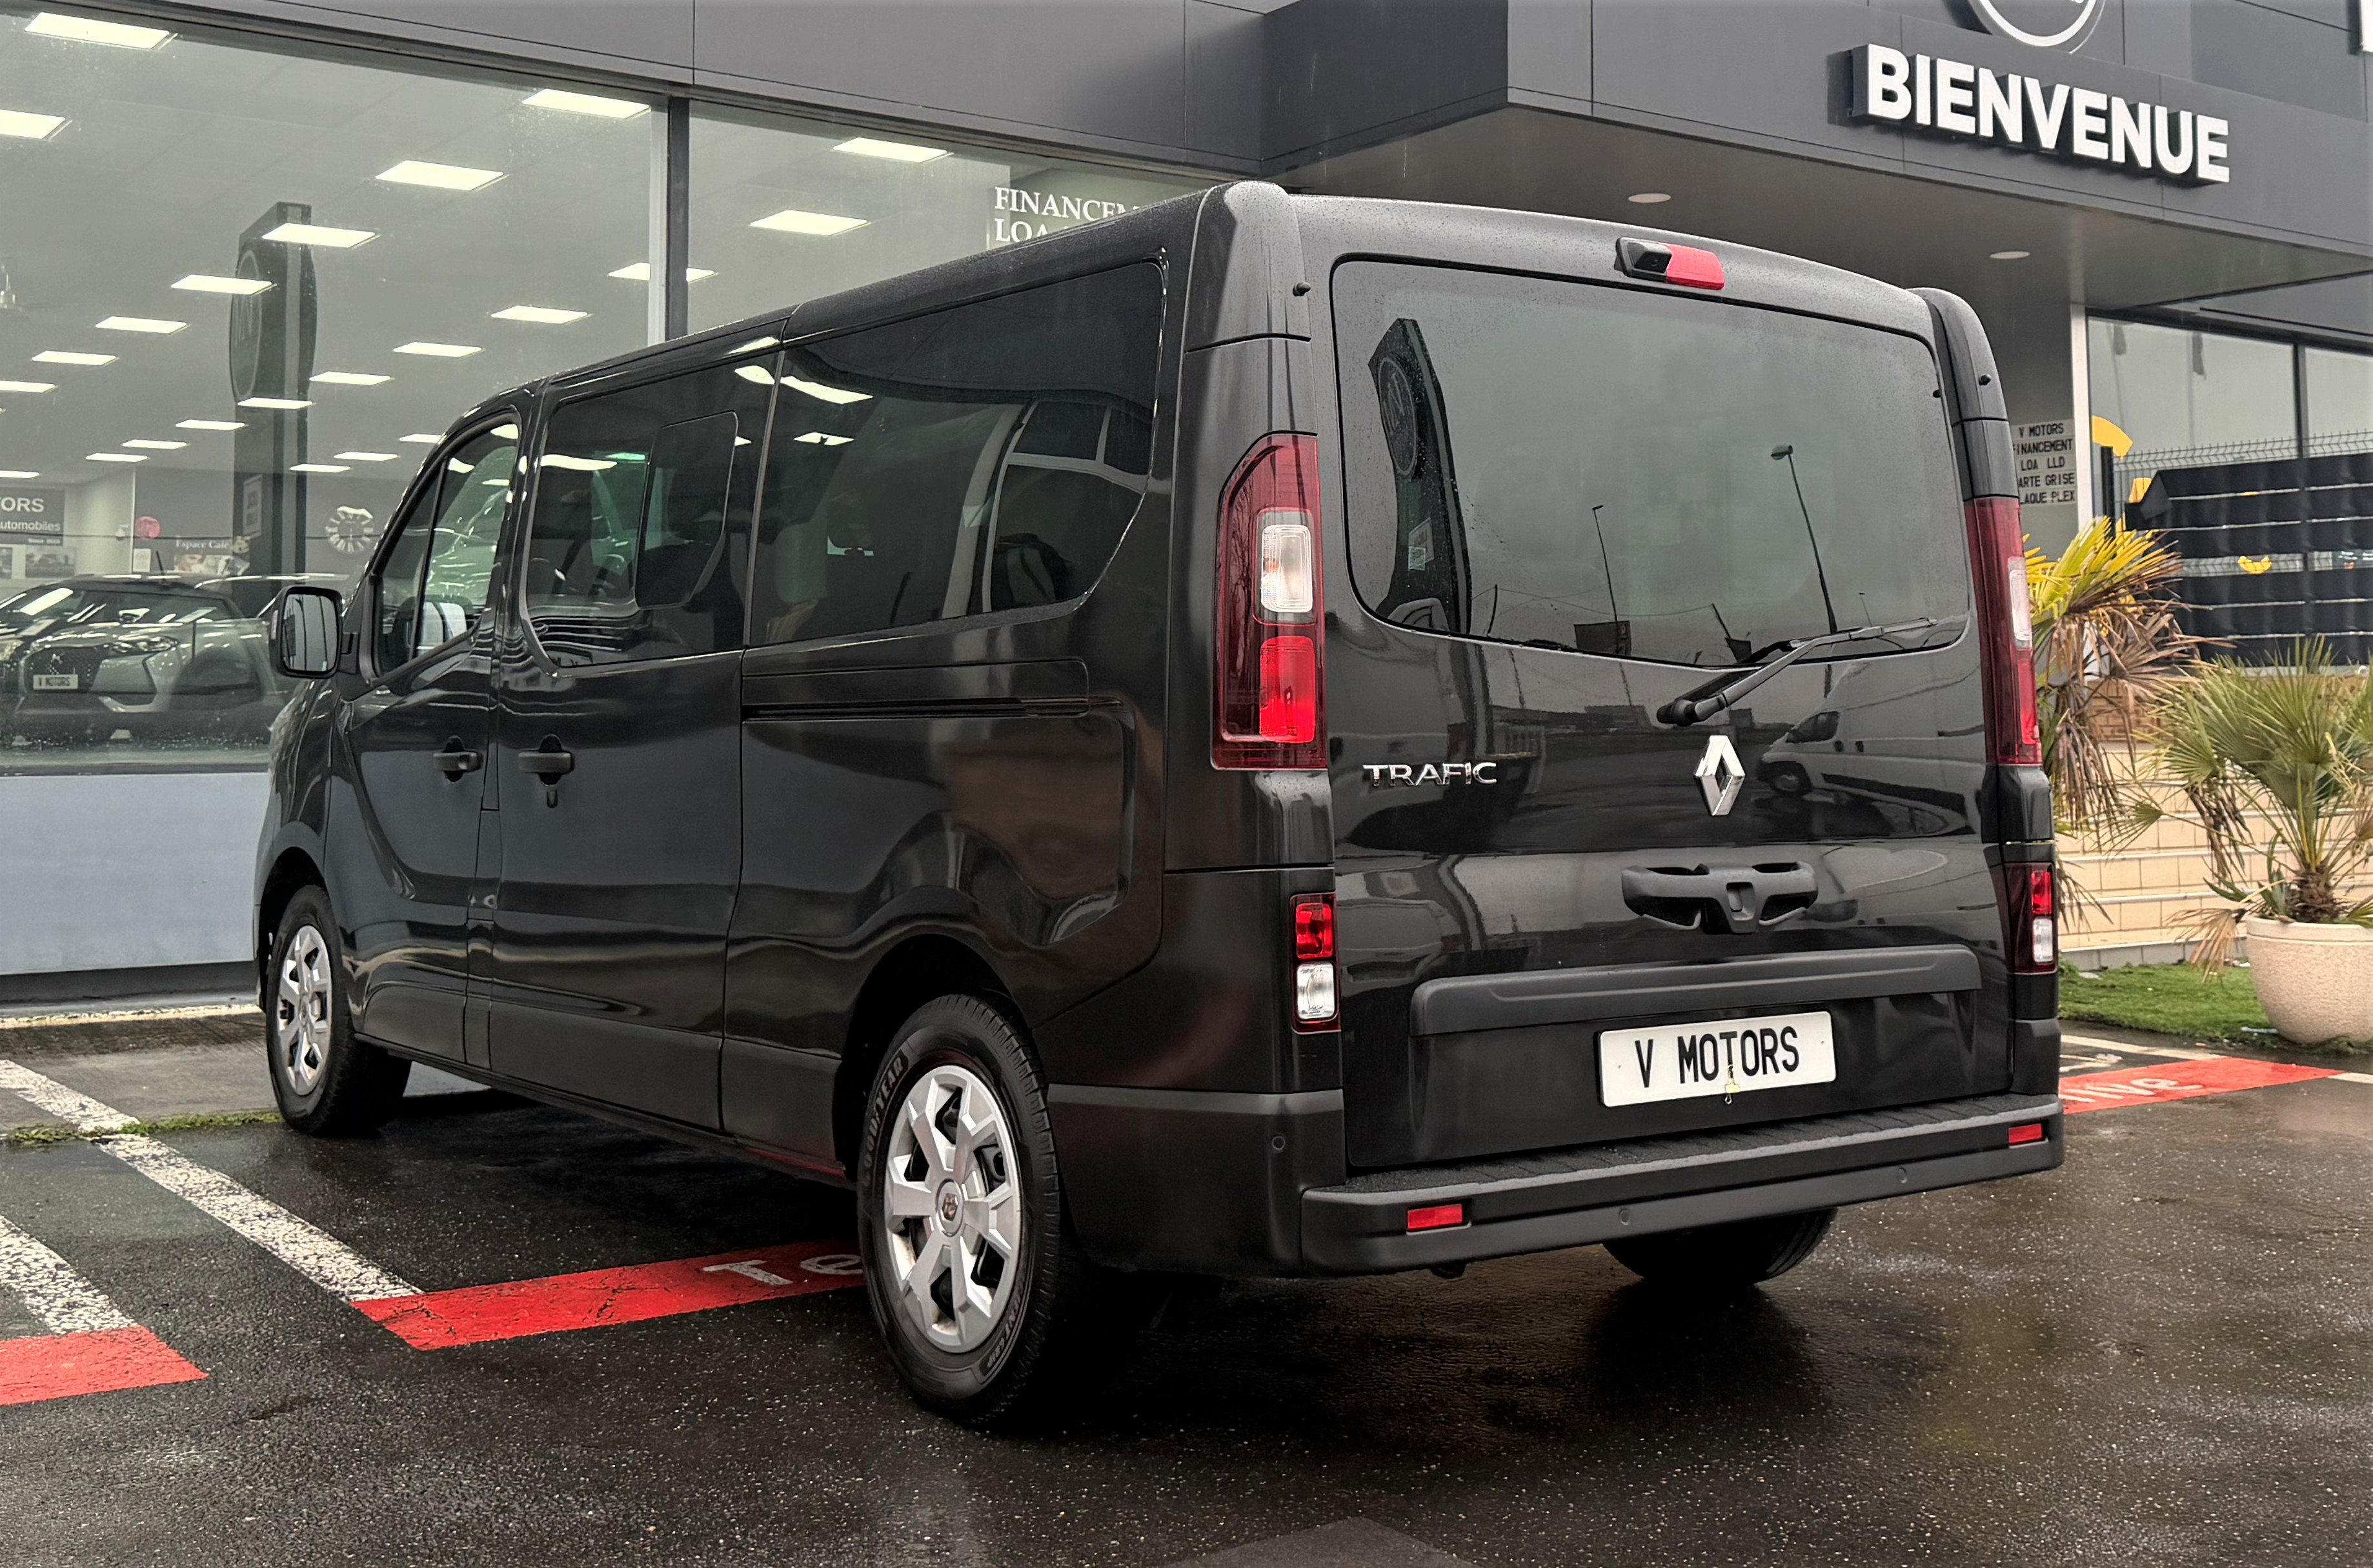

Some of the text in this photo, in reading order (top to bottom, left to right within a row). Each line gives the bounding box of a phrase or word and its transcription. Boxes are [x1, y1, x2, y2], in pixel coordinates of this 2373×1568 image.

[1866, 43, 2230, 183] BIENVENUE
[2019, 423, 2064, 438] V MOTORS
[2021, 456, 2065, 471] LOA LLD
[2018, 472, 2075, 488] ARTE GRISE
[2051, 490, 2075, 503] PLEX
[0, 497, 44, 512] ORS
[0, 520, 61, 531] utomobiles
[1362, 761, 1497, 787] TRAFIC
[1635, 1026, 1799, 1088] V MOTORS
